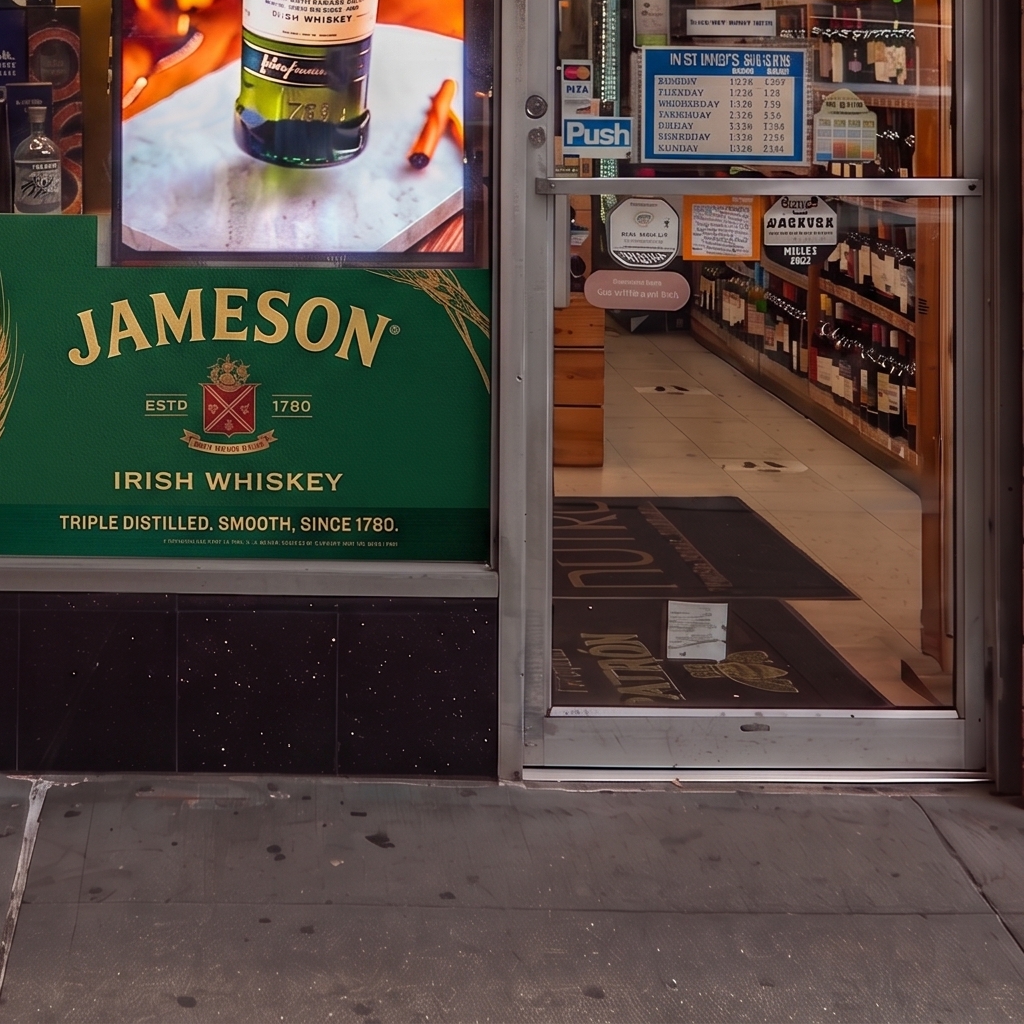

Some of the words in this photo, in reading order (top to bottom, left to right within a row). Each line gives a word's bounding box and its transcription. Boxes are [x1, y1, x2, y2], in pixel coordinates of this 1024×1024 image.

[304, 14, 353, 23] WHISKEY
[566, 121, 630, 145] Push
[68, 287, 393, 368] JAMESON
[145, 400, 188, 411] ESTD
[272, 400, 311, 412] 1780
[114, 471, 193, 490] IRISH
[205, 472, 344, 491] WHISKEY
[59, 515, 118, 530] TRIPLE
[123, 515, 213, 531] DISTILLED.
[218, 516, 296, 534] SMOOTH,
[300, 517, 351, 532] SINCE
[356, 518, 399, 532] 1780.
